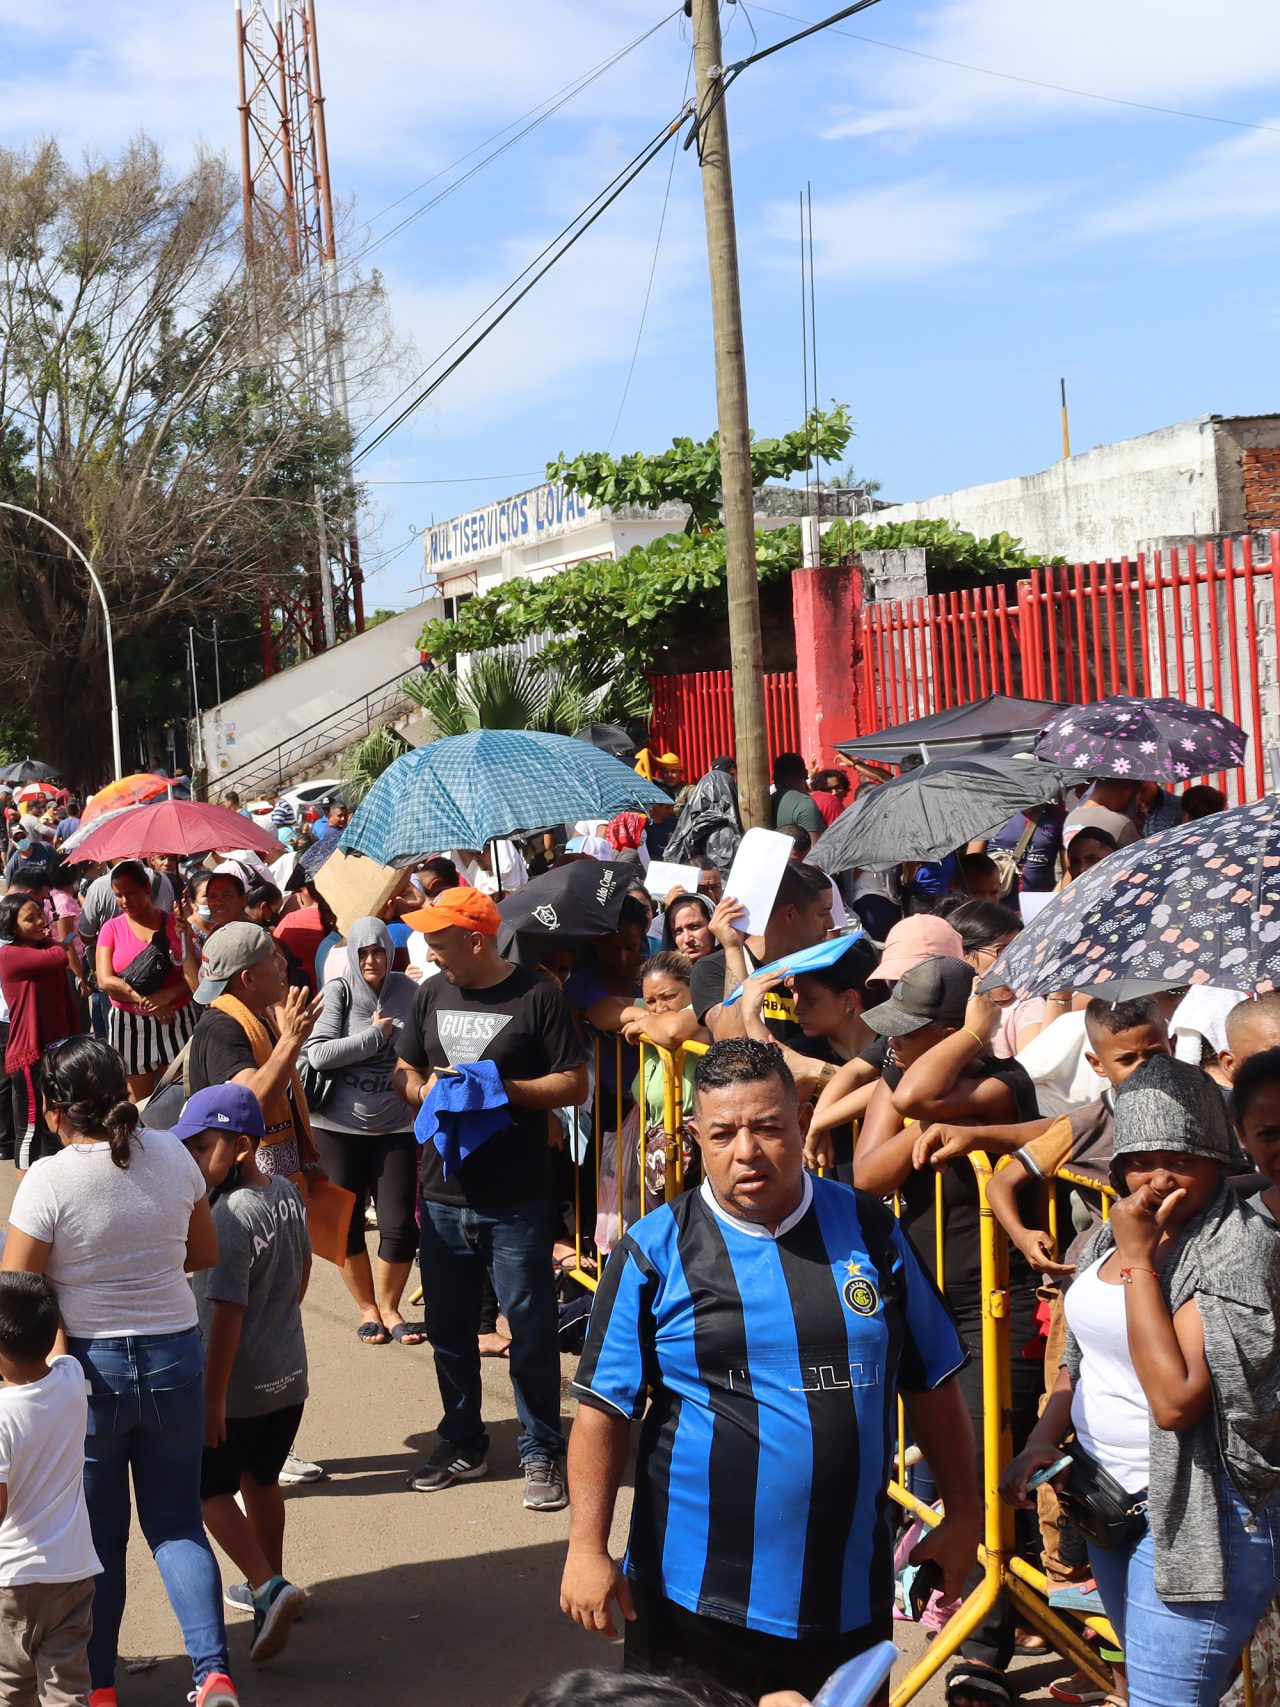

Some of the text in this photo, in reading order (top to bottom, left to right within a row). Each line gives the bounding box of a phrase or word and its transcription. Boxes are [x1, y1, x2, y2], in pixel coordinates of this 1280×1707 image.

[430, 496, 527, 564] MULTISERVICIOS
[596, 868, 614, 906] Aldo Conti
[440, 1015, 495, 1040] GUESS
